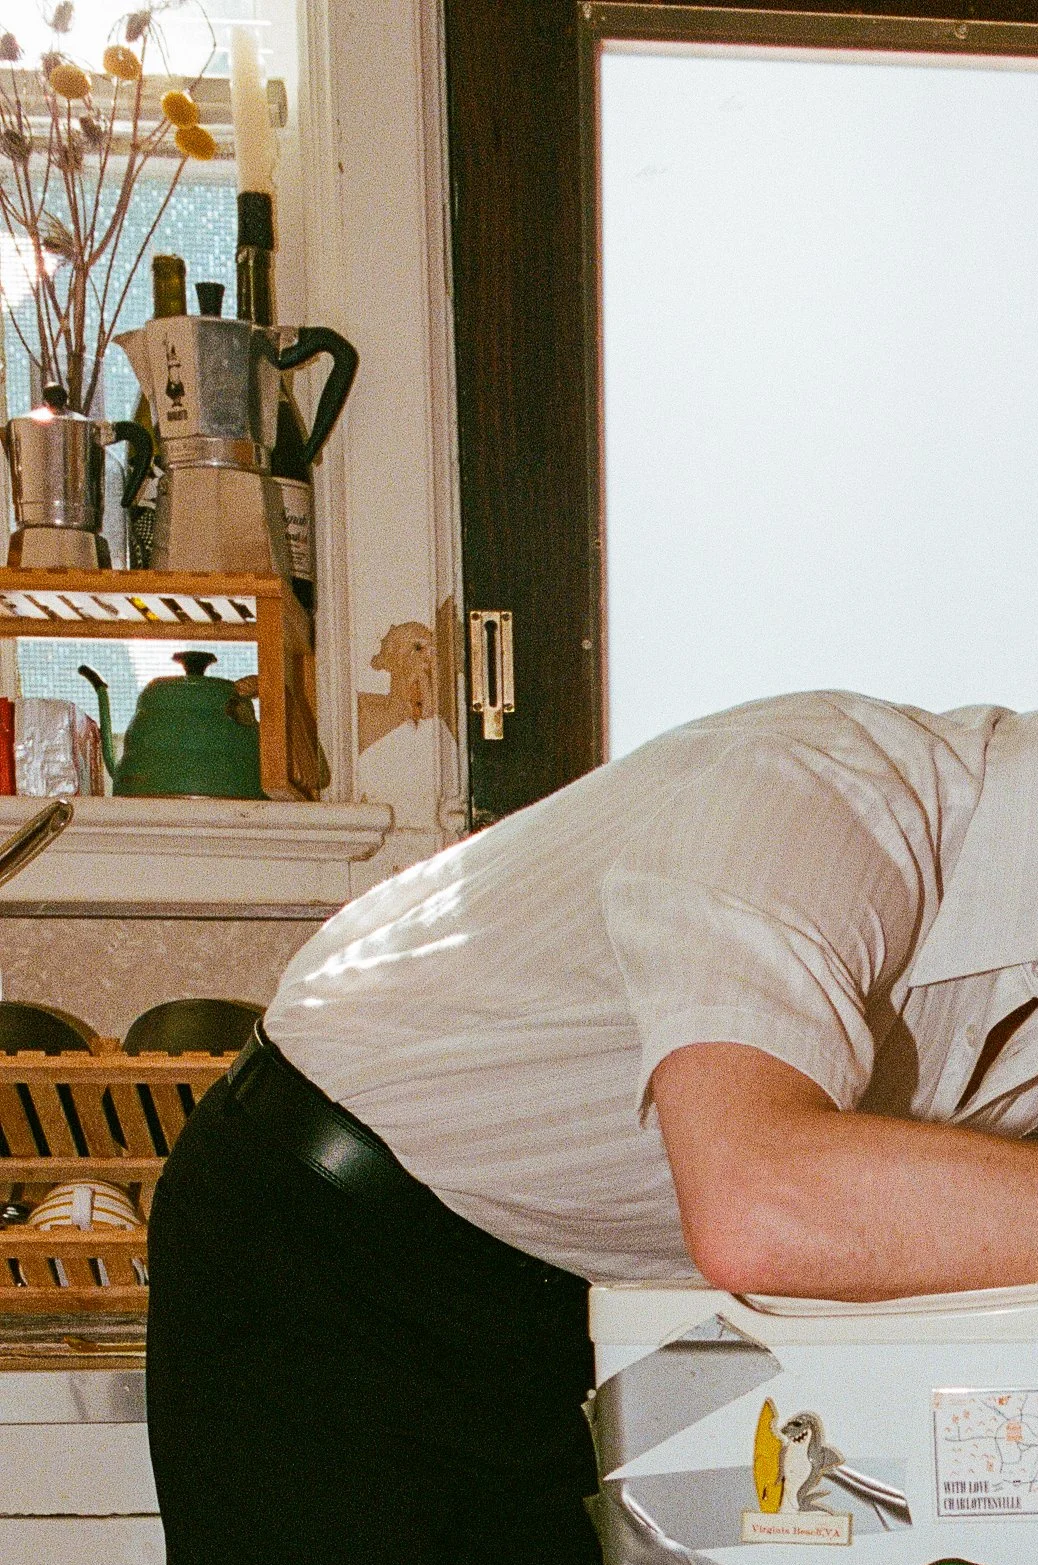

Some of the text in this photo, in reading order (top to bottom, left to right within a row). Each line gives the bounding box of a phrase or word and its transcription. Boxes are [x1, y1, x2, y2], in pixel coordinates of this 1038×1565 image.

[943, 1480, 989, 1494] WITH LOVE
[943, 1496, 1022, 1510] CHARLOTTESVILLE
